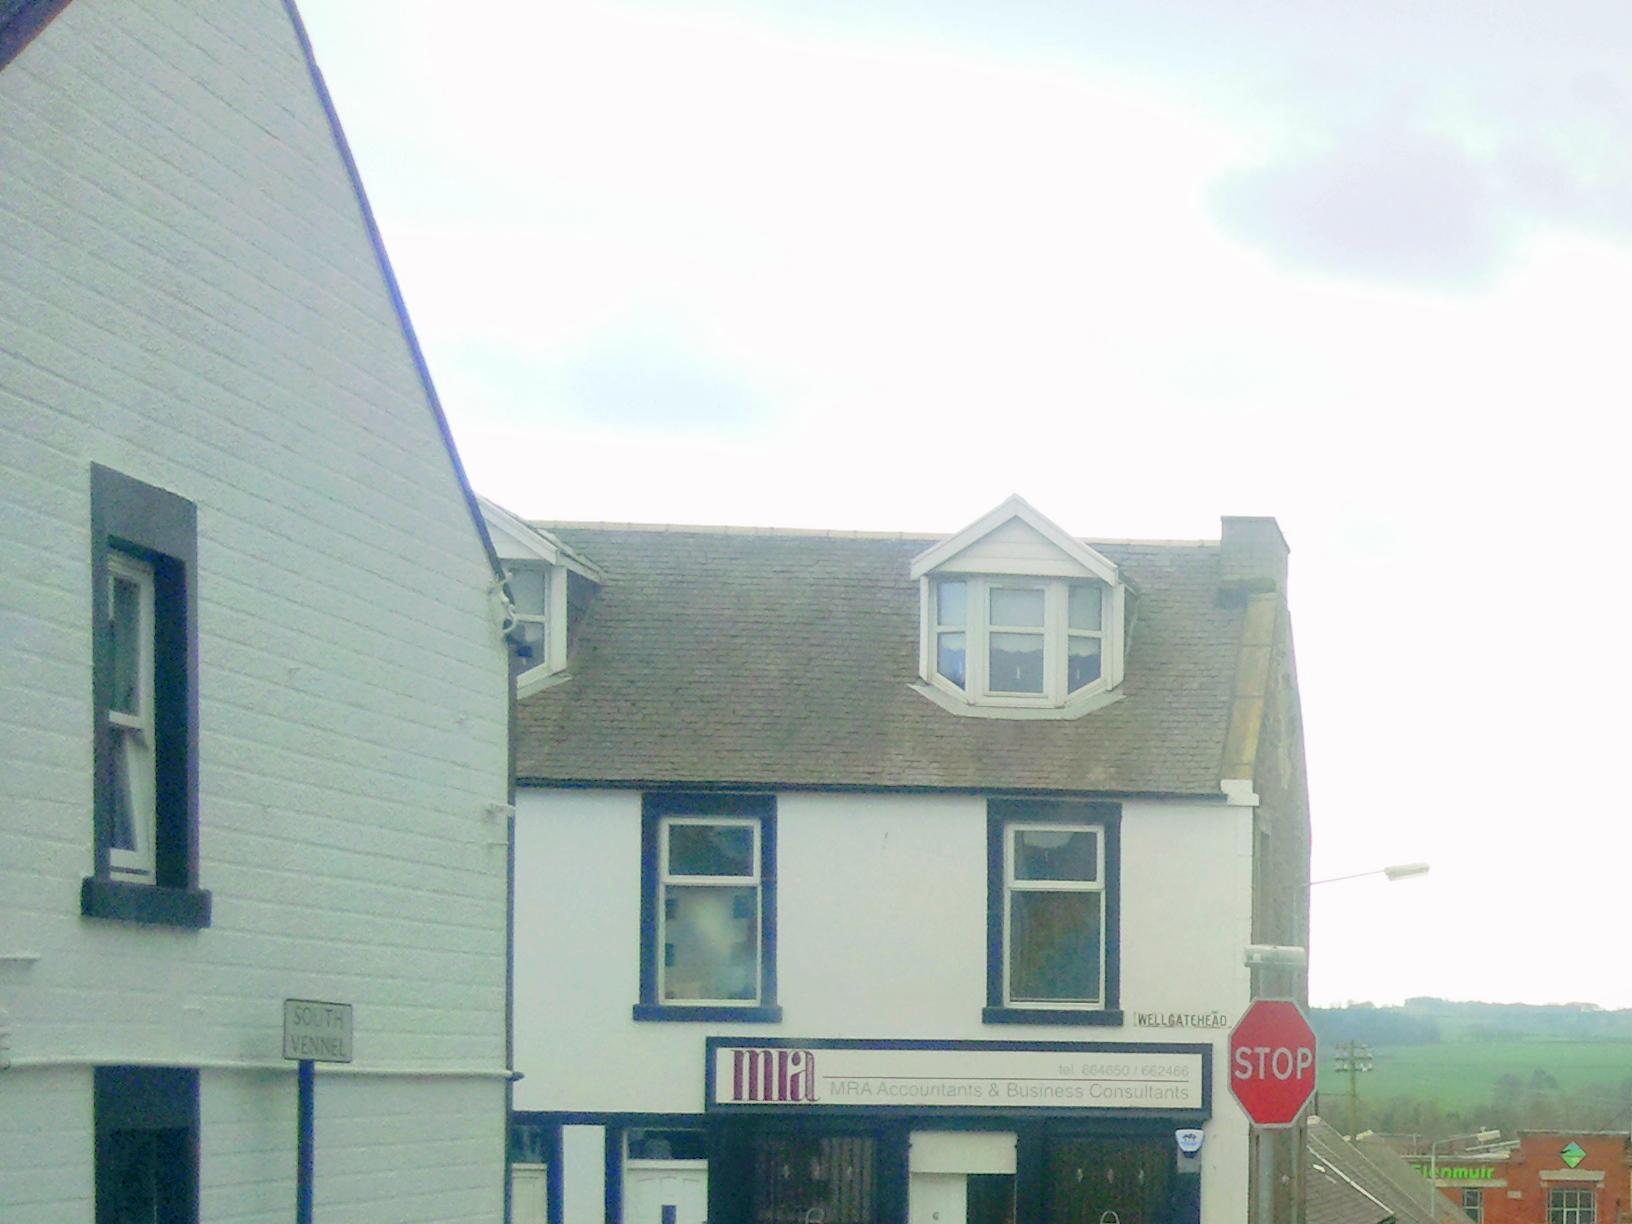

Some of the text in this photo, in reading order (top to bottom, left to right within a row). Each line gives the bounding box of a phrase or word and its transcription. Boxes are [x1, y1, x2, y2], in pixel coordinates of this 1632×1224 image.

[294, 1006, 344, 1029] SOUTH
[1138, 1014, 1227, 1028] WELLGATEHEAD
[290, 1035, 347, 1057] VENNEL
[1235, 1046, 1313, 1080] STOP
[731, 1049, 821, 1102] mra
[830, 1080, 1189, 1100] MRA Accountants & Business Consultants
